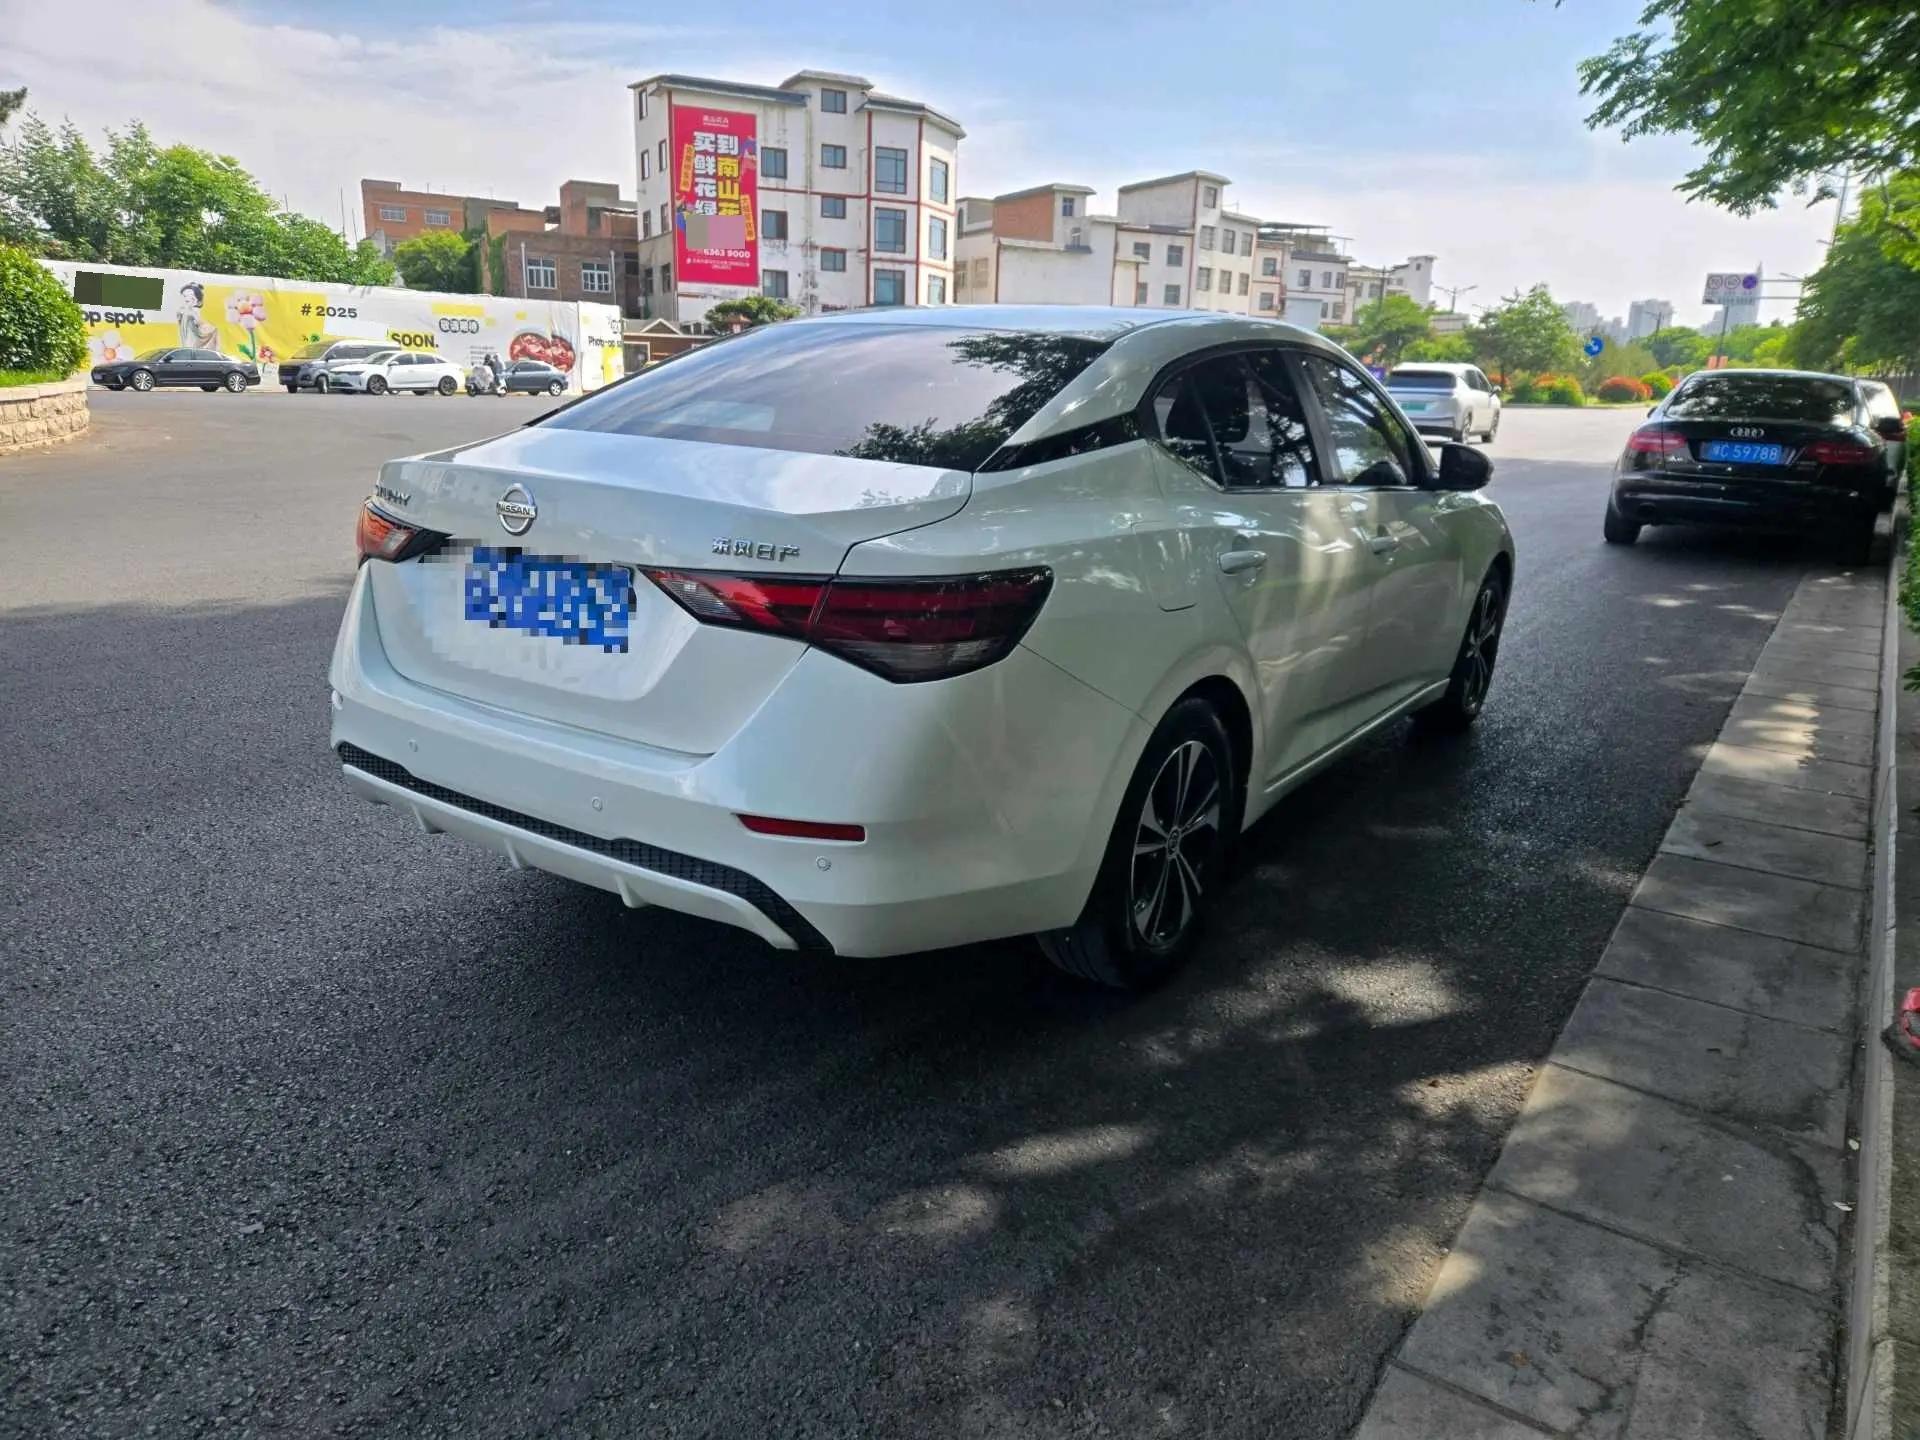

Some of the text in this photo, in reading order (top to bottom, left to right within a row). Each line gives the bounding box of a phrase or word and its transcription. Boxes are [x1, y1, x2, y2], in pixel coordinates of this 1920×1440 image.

[104, 310, 145, 328] spot
[315, 306, 358, 319] 2025
[391, 333, 439, 348] SOON.
[1732, 444, 1778, 461] 59788
[497, 502, 530, 516] NISSAN
[712, 537, 800, 562] 东风日产
